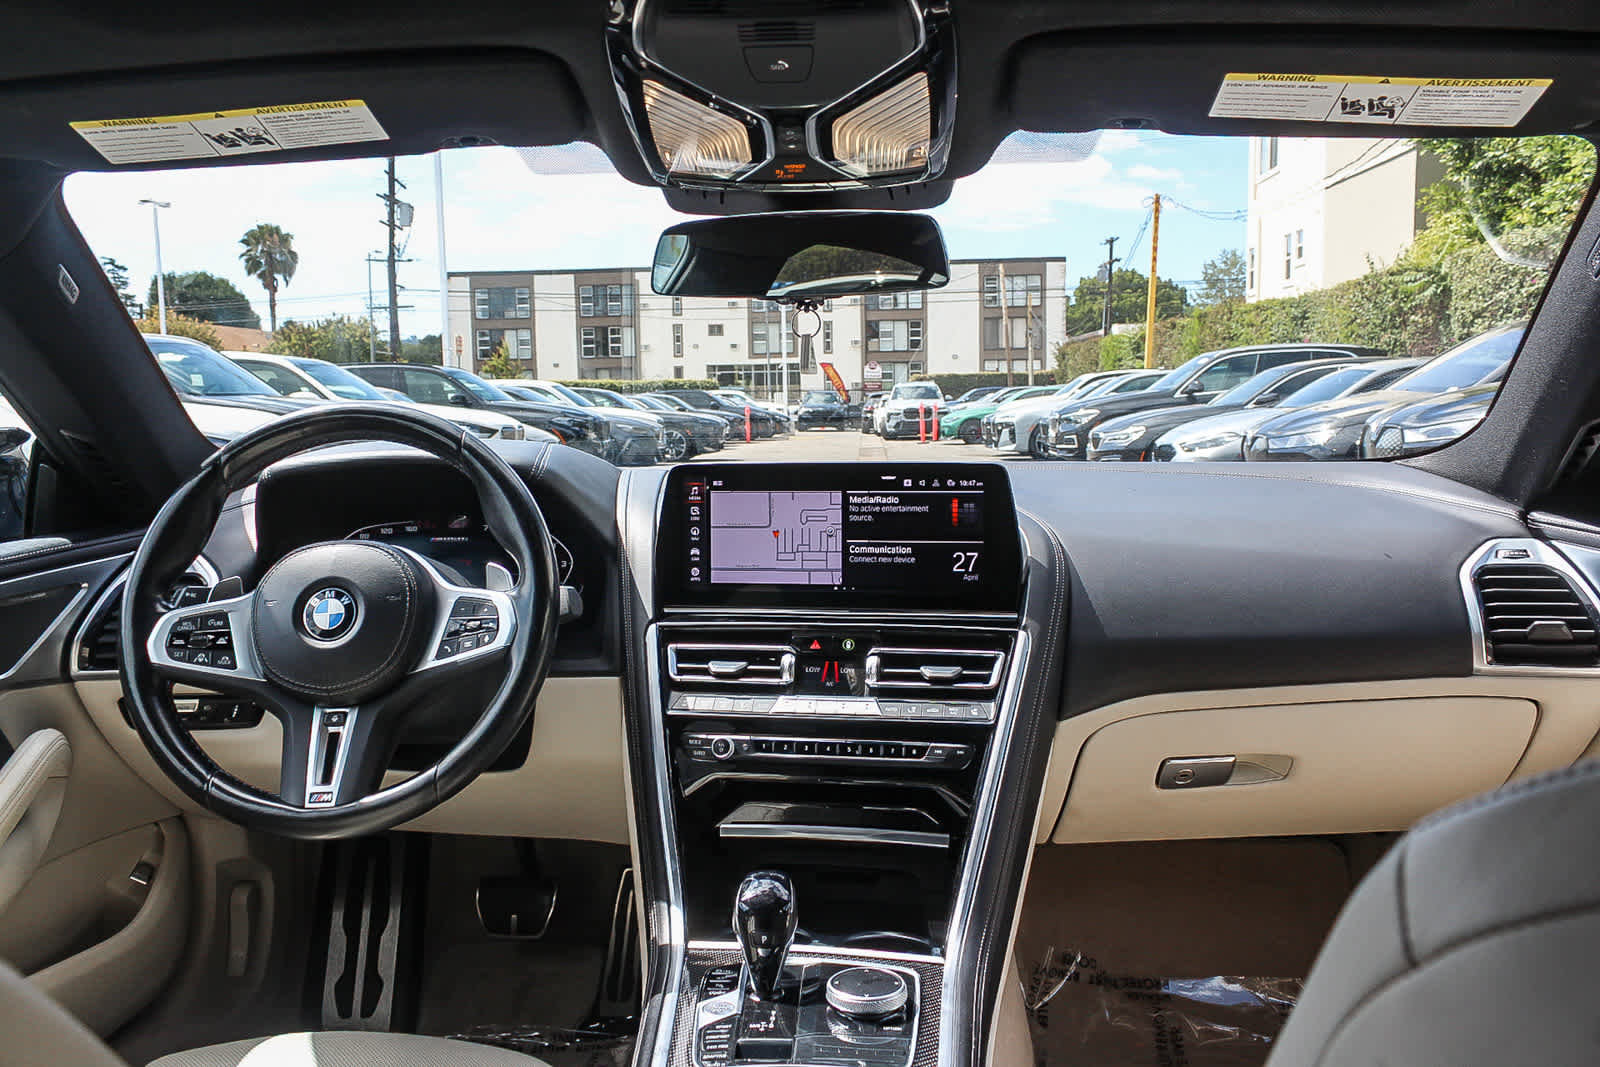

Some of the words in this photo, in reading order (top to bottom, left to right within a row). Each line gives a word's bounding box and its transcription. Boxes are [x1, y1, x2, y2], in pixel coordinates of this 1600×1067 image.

[1257, 74, 1317, 82] WARNING
[1425, 79, 1534, 87] AVERTISSEMENT
[256, 102, 348, 114] AVERTISSEMENT
[101, 119, 157, 127] WARNING
[849, 496, 899, 504] Media/Radio
[849, 545, 912, 554] Communication
[952, 552, 979, 572] 27
[311, 591, 351, 607] BMW
